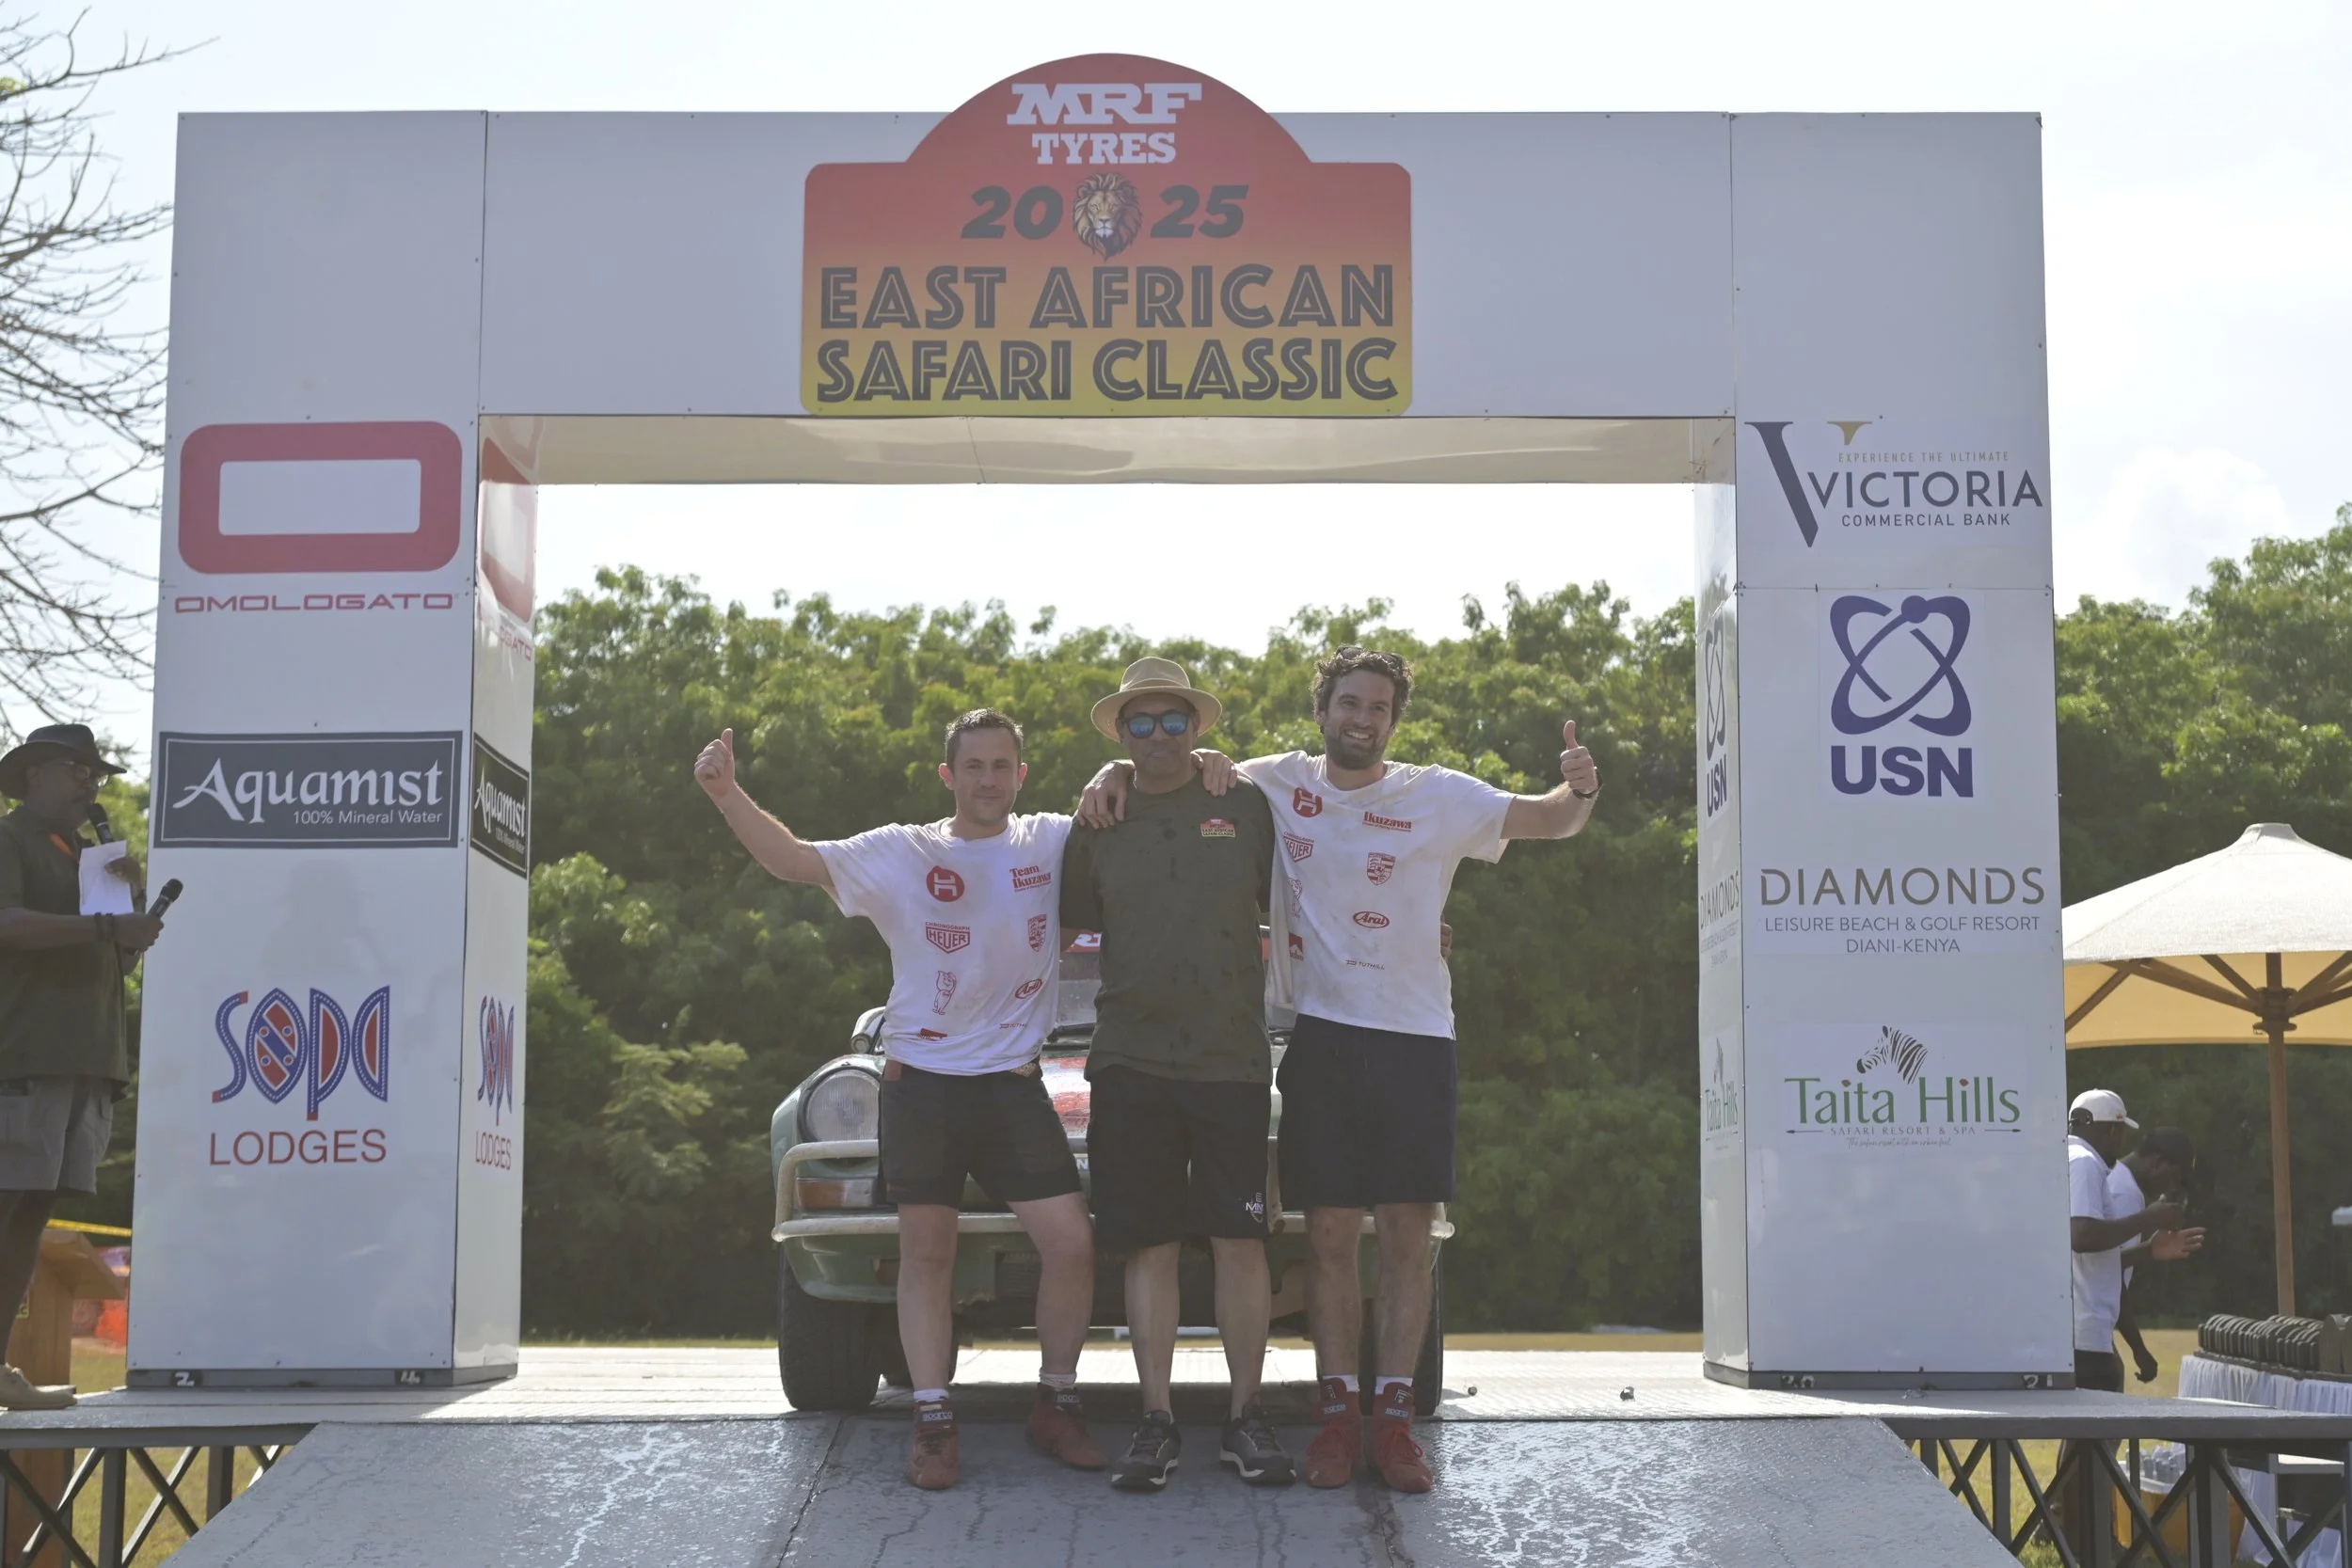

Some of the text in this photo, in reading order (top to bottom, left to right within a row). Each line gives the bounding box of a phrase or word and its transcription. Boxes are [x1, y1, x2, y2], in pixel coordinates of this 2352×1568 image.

[1007, 83, 1201, 124] MRF
[1032, 133, 1176, 164] TYRES
[961, 185, 1248, 239] 20 25
[820, 263, 1393, 329] EAST AFRICAN
[817, 338, 1399, 402] SAFARI CLASSIC
[1838, 451, 2009, 463] EXPERIENCE THE ULTIMATE
[1807, 469, 2042, 509] VICTORIA
[1841, 513, 2010, 527] COMMERCIAL BANK
[175, 594, 453, 613] OMOLOGATO
[172, 757, 443, 824] Aquamist
[1707, 752, 1727, 817] USN
[1830, 745, 1974, 798] USN
[293, 809, 443, 824] 100% Mineral Water
[474, 766, 526, 838] Aquamist
[1009, 865, 1040, 878] Team
[1761, 867, 2044, 906] DIAMONDS
[1700, 870, 1740, 930] DIAMONDS
[929, 930, 967, 949] HEUER
[1765, 915, 2040, 932] LEISURE BEACH & GOLF RESORT
[1846, 938, 1961, 953] DIANI-KENYA
[1784, 1076, 2021, 1125] Taita Hills
[209, 1129, 387, 1166] LODGES
[1831, 1126, 1976, 1135] SAFARI RESORT & SPA
[475, 1131, 512, 1170] LODGES
